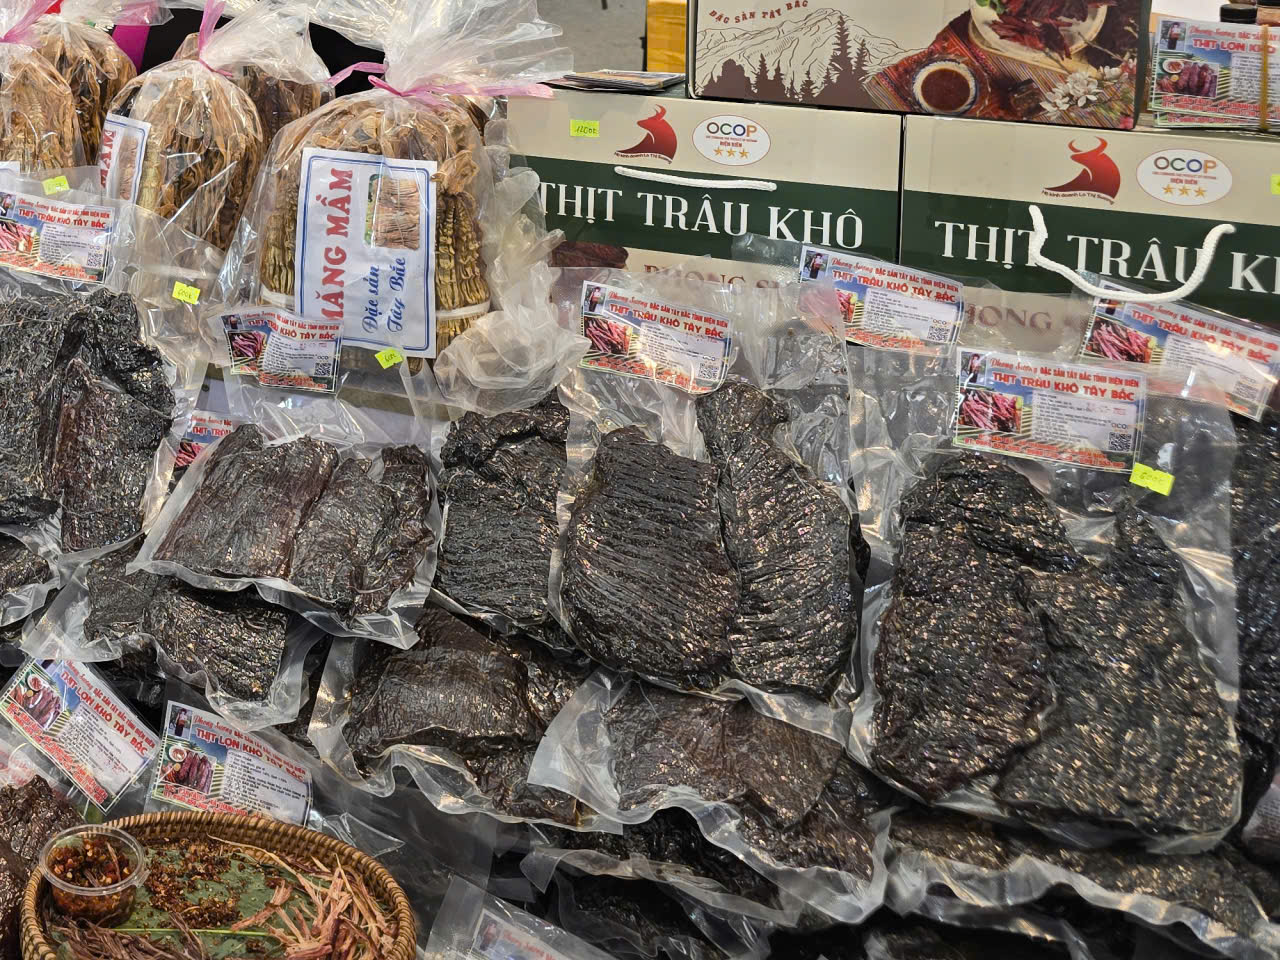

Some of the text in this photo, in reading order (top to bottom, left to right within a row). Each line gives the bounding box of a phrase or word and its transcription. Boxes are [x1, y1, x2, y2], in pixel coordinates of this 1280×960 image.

[708, 9, 730, 24] ĐẶC
[734, 10, 756, 24] SẢN
[761, 8, 783, 20] TÂY
[706, 120, 758, 138] OCOP
[1153, 156, 1217, 175] OCOP
[73, 219, 88, 227] TÂY
[91, 220, 107, 229] BẮC
[538, 181, 864, 249] THỊT TRÂU KHÔ
[832, 270, 956, 303] THỊT TRÂU KHÔ TÂY BẮC
[875, 267, 920, 283] ĐẶC SẢN TÂY BẮC
[386, 257, 406, 332] Tây Bắc
[280, 326, 336, 340] KHÔ TÂY BẮC
[609, 303, 724, 339] THỊT TRÂU KHÔ TÂY BẮC
[1131, 309, 1154, 323] THỊT
[1157, 318, 1188, 335] TRÂU
[1248, 348, 1271, 363] BẮC
[993, 372, 1135, 402] THỊT TRÂU KHÔ TÂY BẮC
[1040, 367, 1053, 376] ĐẶC
[1053, 368, 1066, 378] SẢN
[1067, 370, 1078, 380] TÂY
[1079, 371, 1092, 382] BẮC
[1093, 373, 1108, 384] TỈNH
[60, 670, 148, 757] THỊT LỢN KHÔ TÂY BẮC
[196, 727, 217, 744] THỊT
[219, 736, 240, 750] LỢN
[242, 743, 263, 757] KHÔ
[265, 755, 284, 768] TÂY
